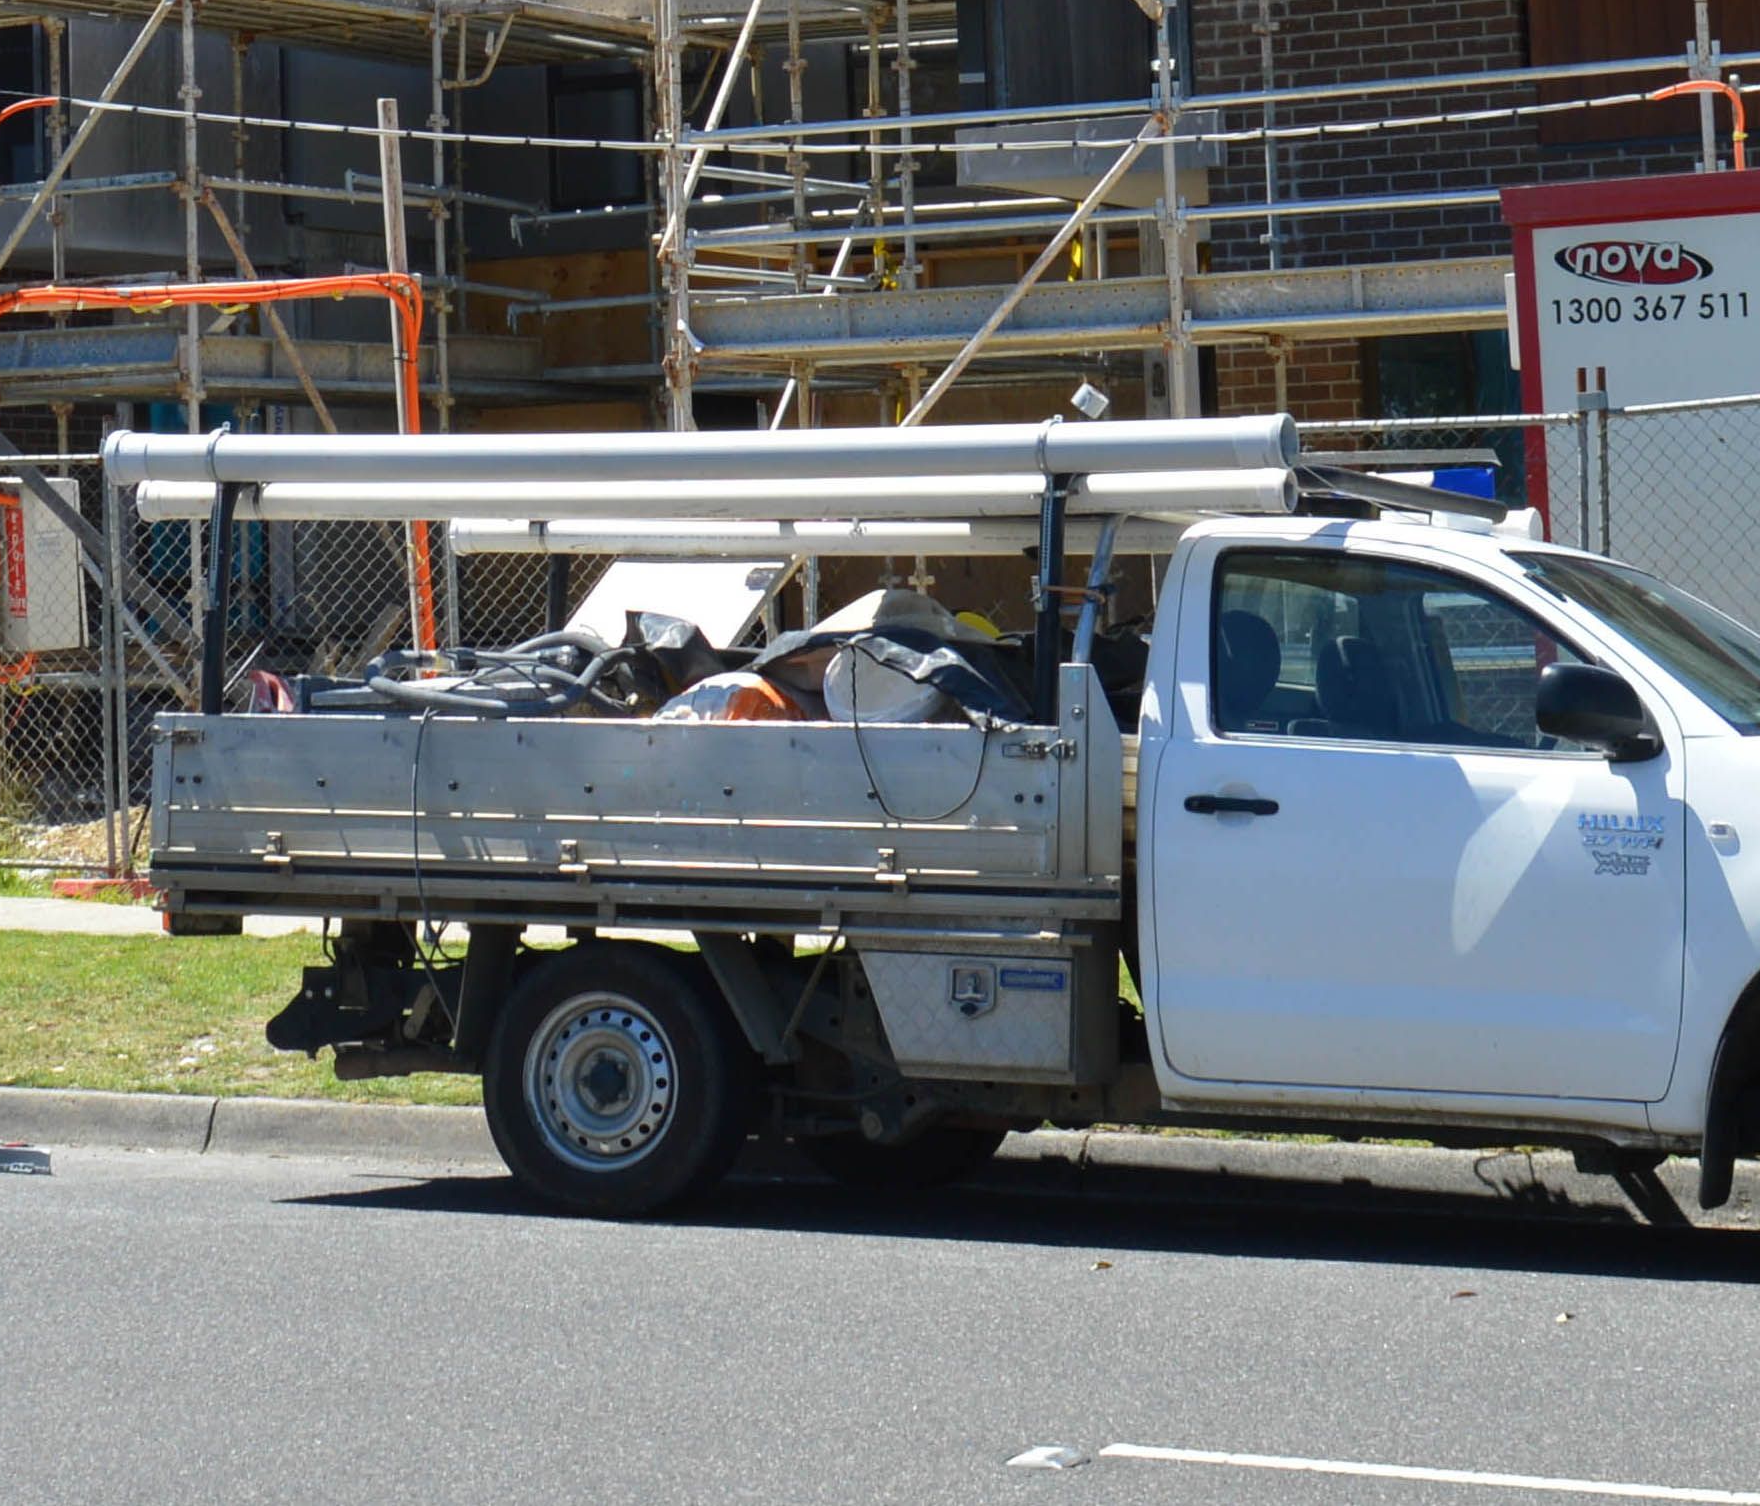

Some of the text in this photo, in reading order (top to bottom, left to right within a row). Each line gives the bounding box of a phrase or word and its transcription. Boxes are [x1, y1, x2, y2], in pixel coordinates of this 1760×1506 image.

[1575, 242, 1683, 275] nova
[1552, 292, 1748, 324] 1300 367 511
[1577, 813, 1664, 832] HILUX
